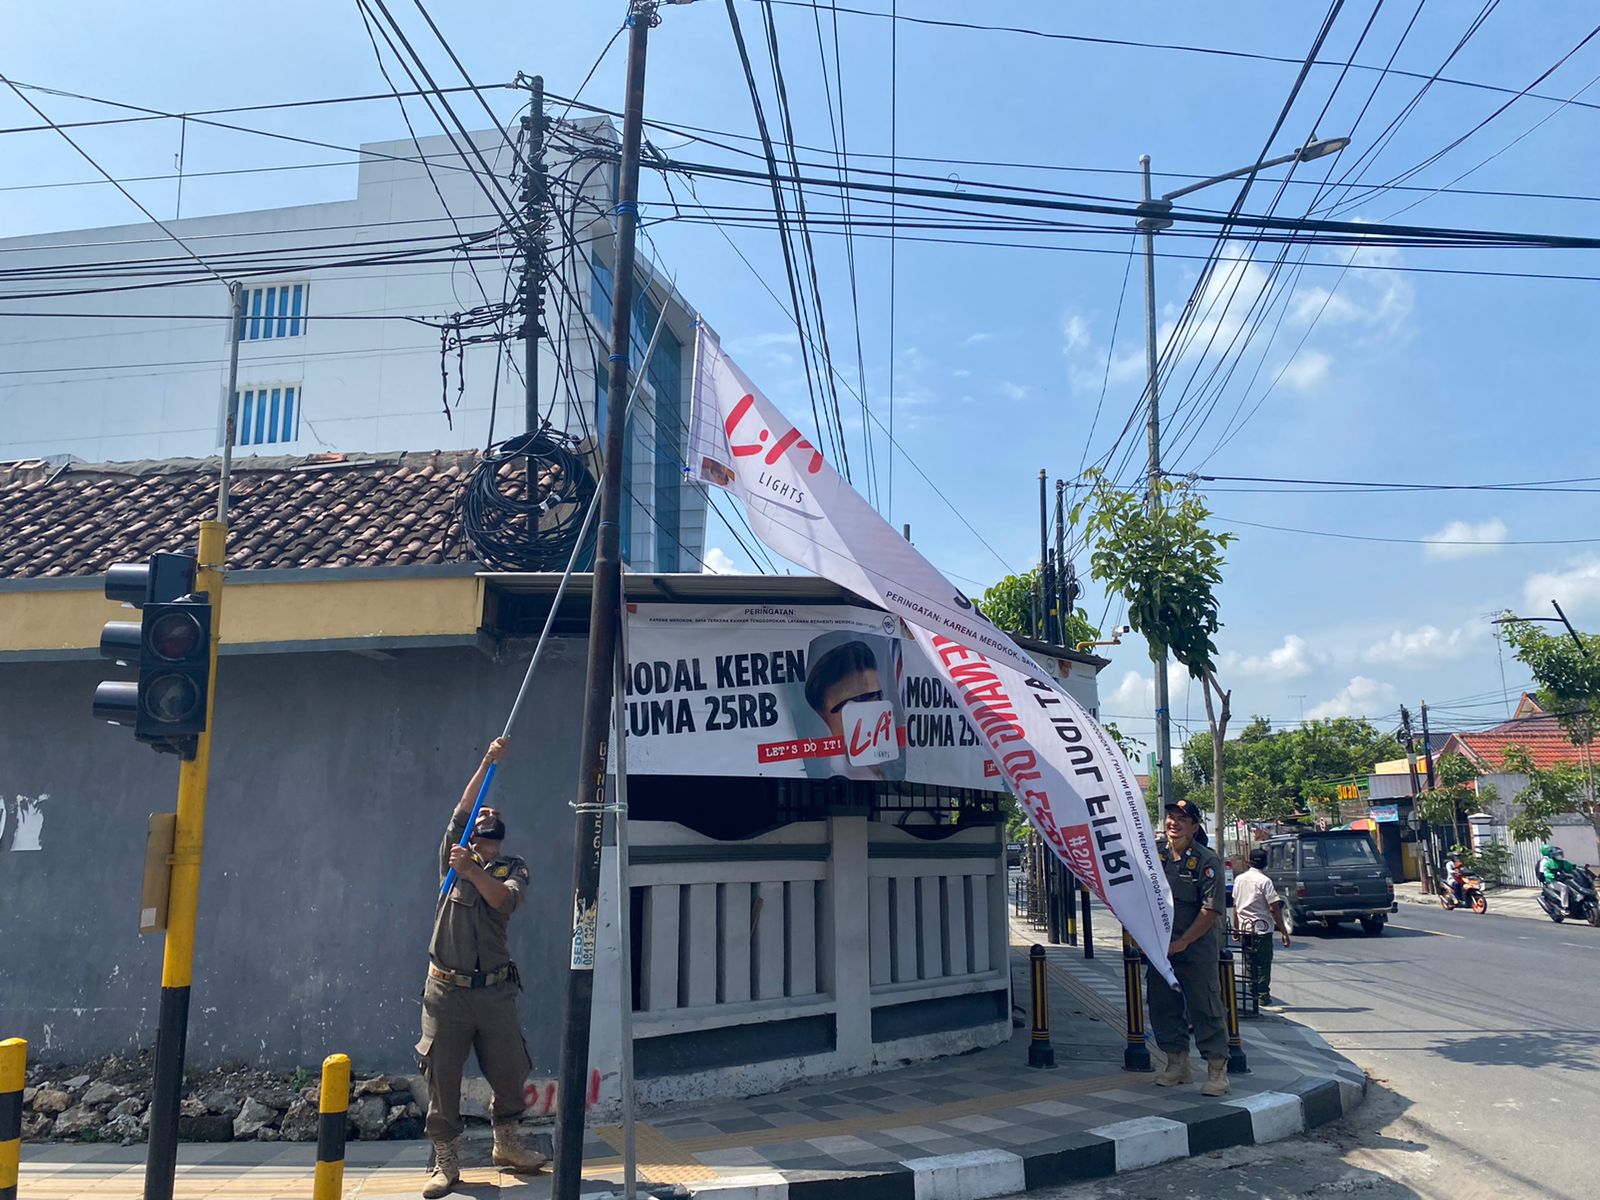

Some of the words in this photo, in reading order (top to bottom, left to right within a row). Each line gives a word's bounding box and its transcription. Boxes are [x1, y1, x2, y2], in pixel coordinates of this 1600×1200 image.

[758, 471, 806, 504] LIGHTS
[744, 608, 797, 616] PERINGATAN:
[885, 590, 942, 623] PERINGATAN:
[943, 618, 978, 641] KARENA
[979, 635, 1020, 661] MEROKOK,
[716, 649, 806, 687] KEREN
[907, 676, 959, 709] MODA
[705, 693, 779, 732] 25RB
[765, 744, 800, 757] LET'S
[803, 742, 818, 754] DO
[823, 740, 842, 751] IT!
[907, 717, 954, 747] CUMA
